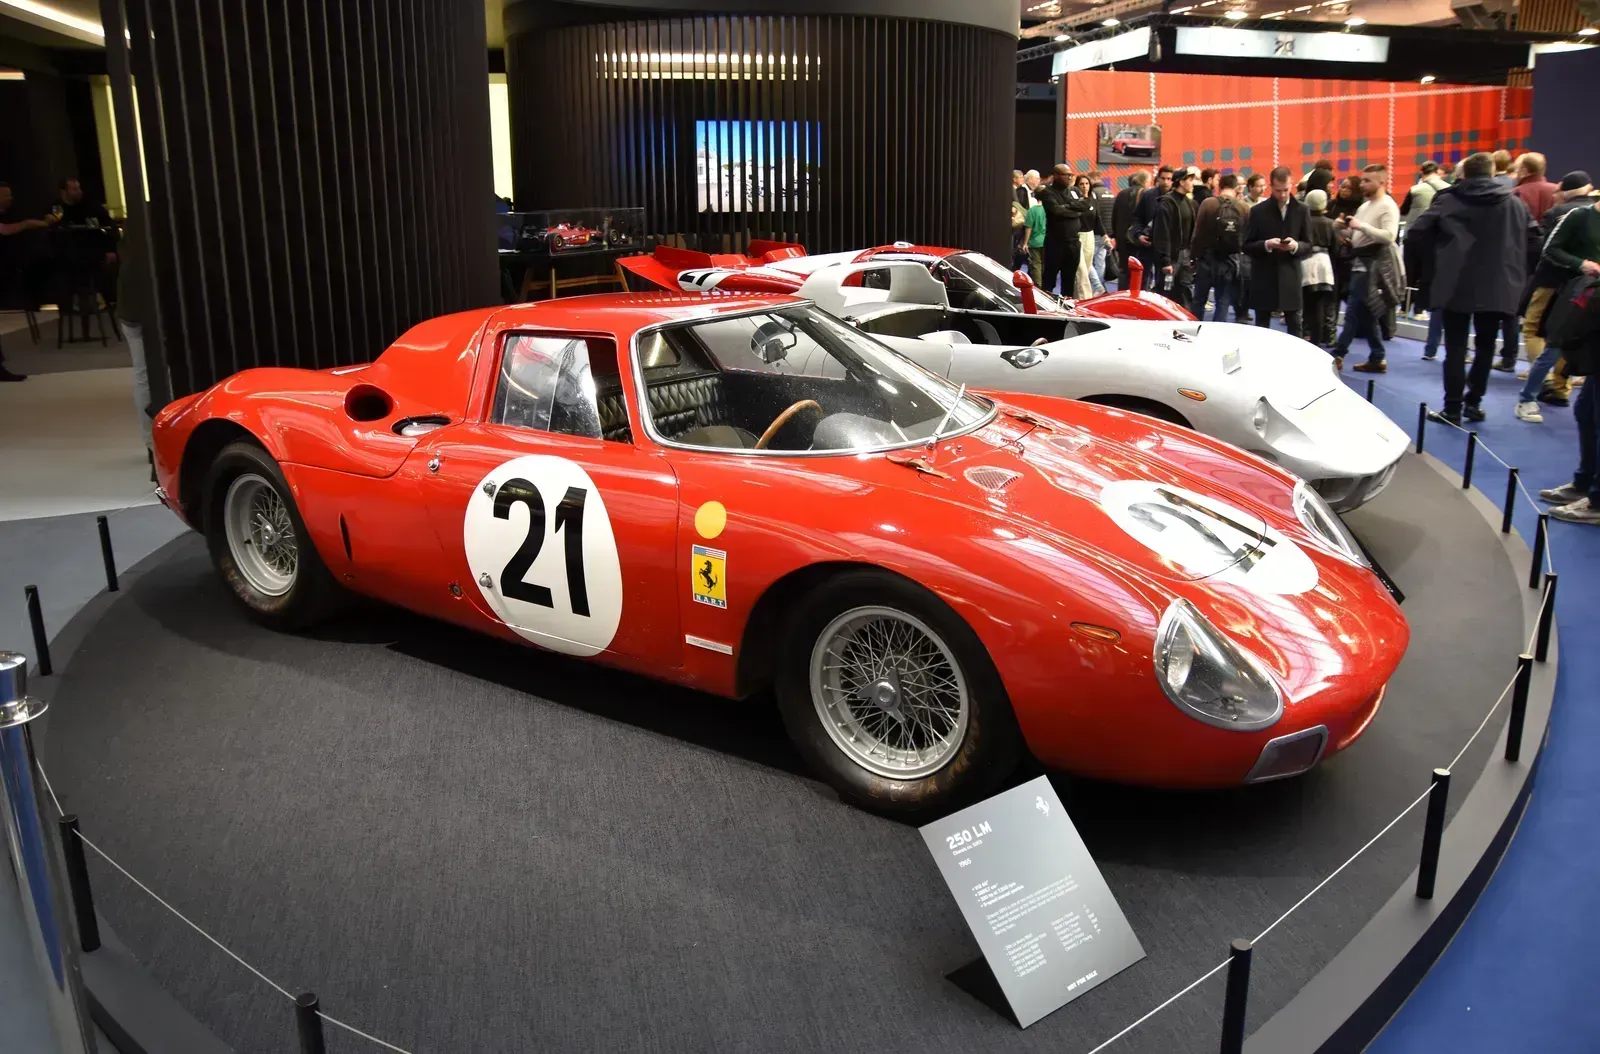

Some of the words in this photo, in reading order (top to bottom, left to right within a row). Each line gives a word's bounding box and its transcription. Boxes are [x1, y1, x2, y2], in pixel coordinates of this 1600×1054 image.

[1127, 487, 1278, 574] 21
[493, 477, 591, 618] 21
[945, 829, 972, 850] 250
[971, 820, 993, 838] LM
[958, 857, 972, 868] 1965
[1066, 981, 1077, 991] NOT
[1076, 976, 1086, 986] FOR
[1085, 970, 1098, 981] SALE
